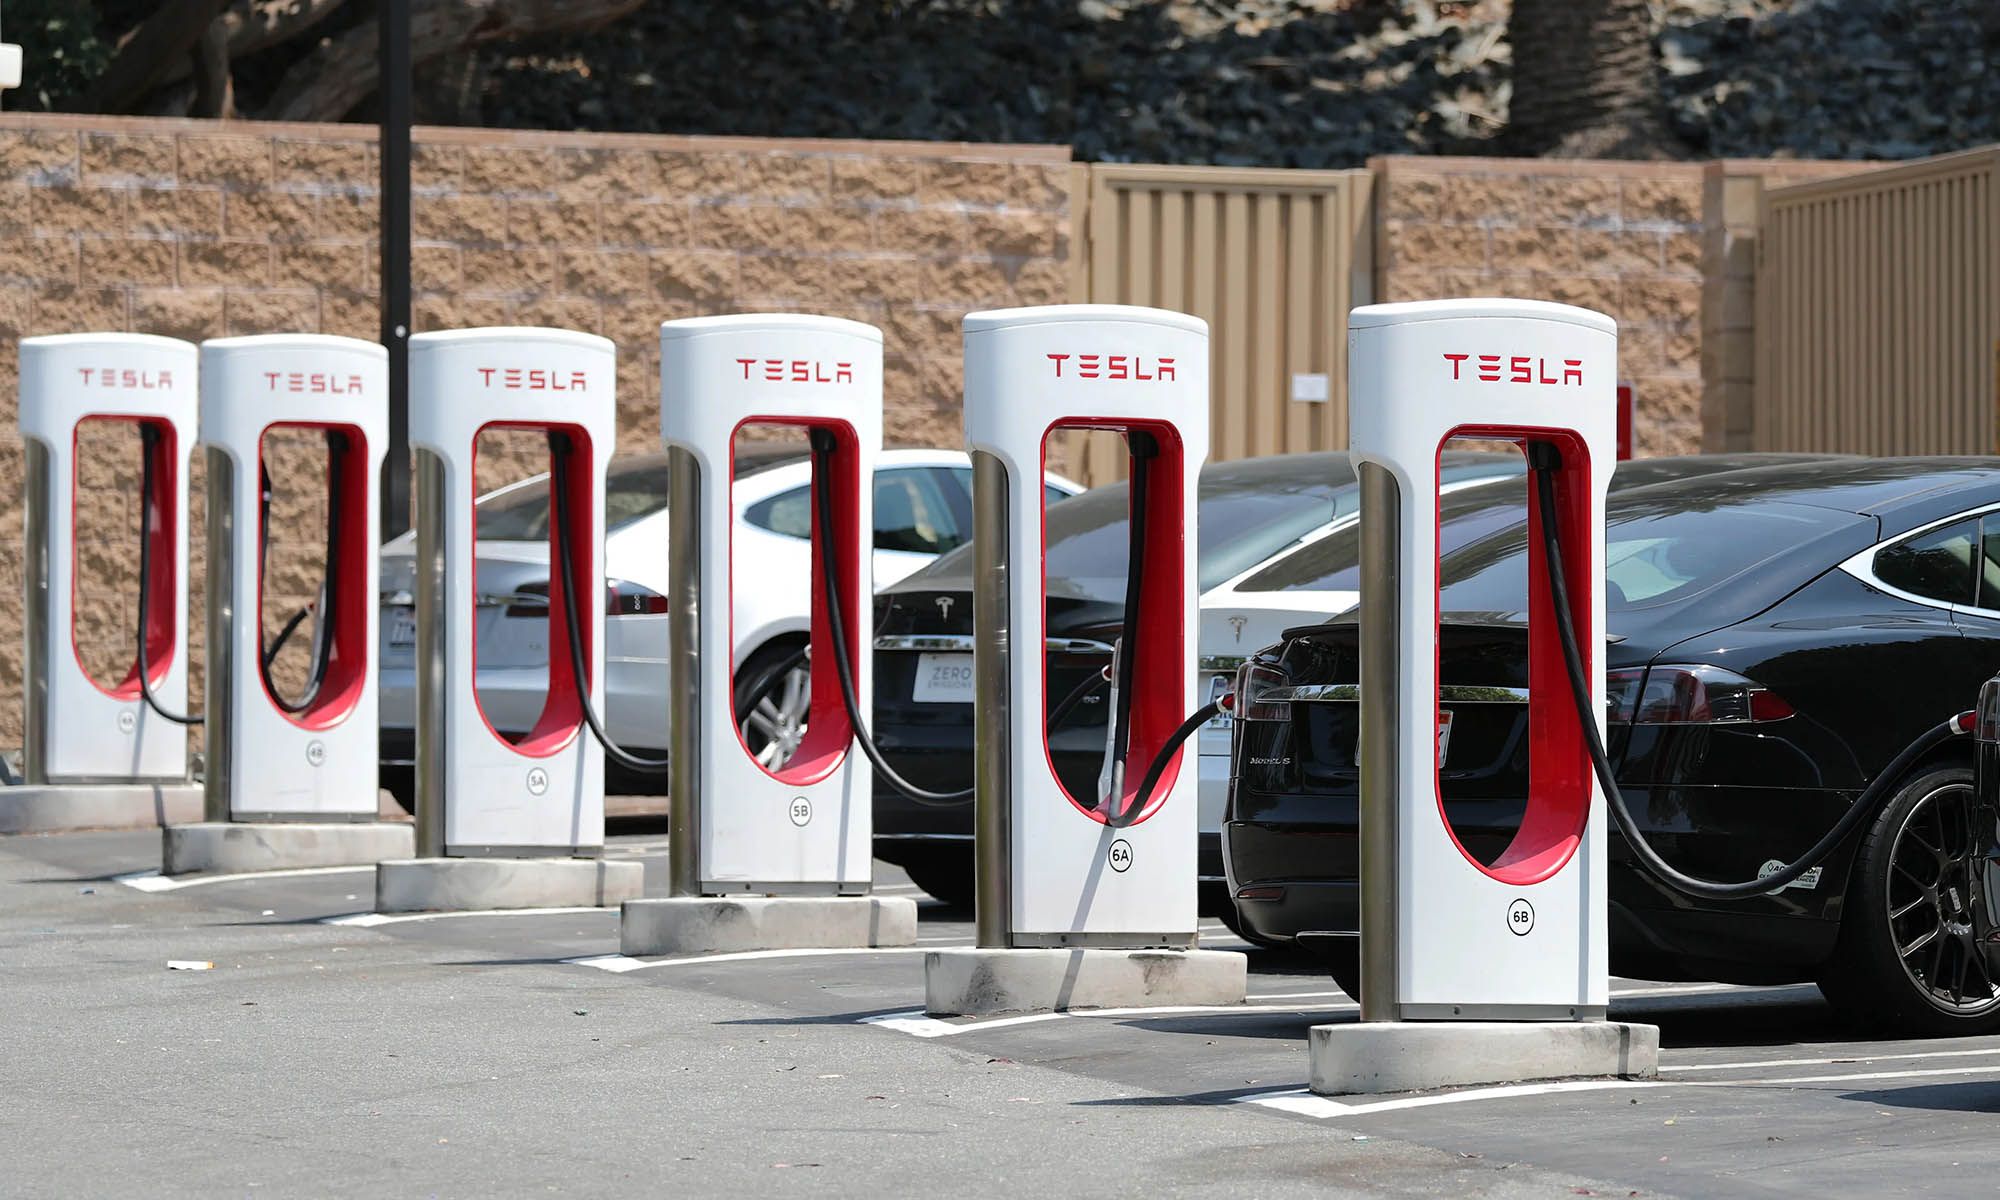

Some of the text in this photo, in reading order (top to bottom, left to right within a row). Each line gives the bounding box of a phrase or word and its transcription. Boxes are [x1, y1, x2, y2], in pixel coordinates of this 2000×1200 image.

[737, 359, 852, 383] TESLA
[1048, 354, 1175, 381] TESLA
[1444, 354, 1582, 384] TESLA
[78, 368, 173, 391] TESLA
[264, 372, 363, 395] TESLA
[478, 368, 587, 391] TESLA
[932, 666, 971, 680] ZERO
[531, 775, 545, 787] 5A
[794, 805, 808, 817] 5B
[1112, 849, 1129, 861] 6A
[1513, 911, 1529, 923] 6B
